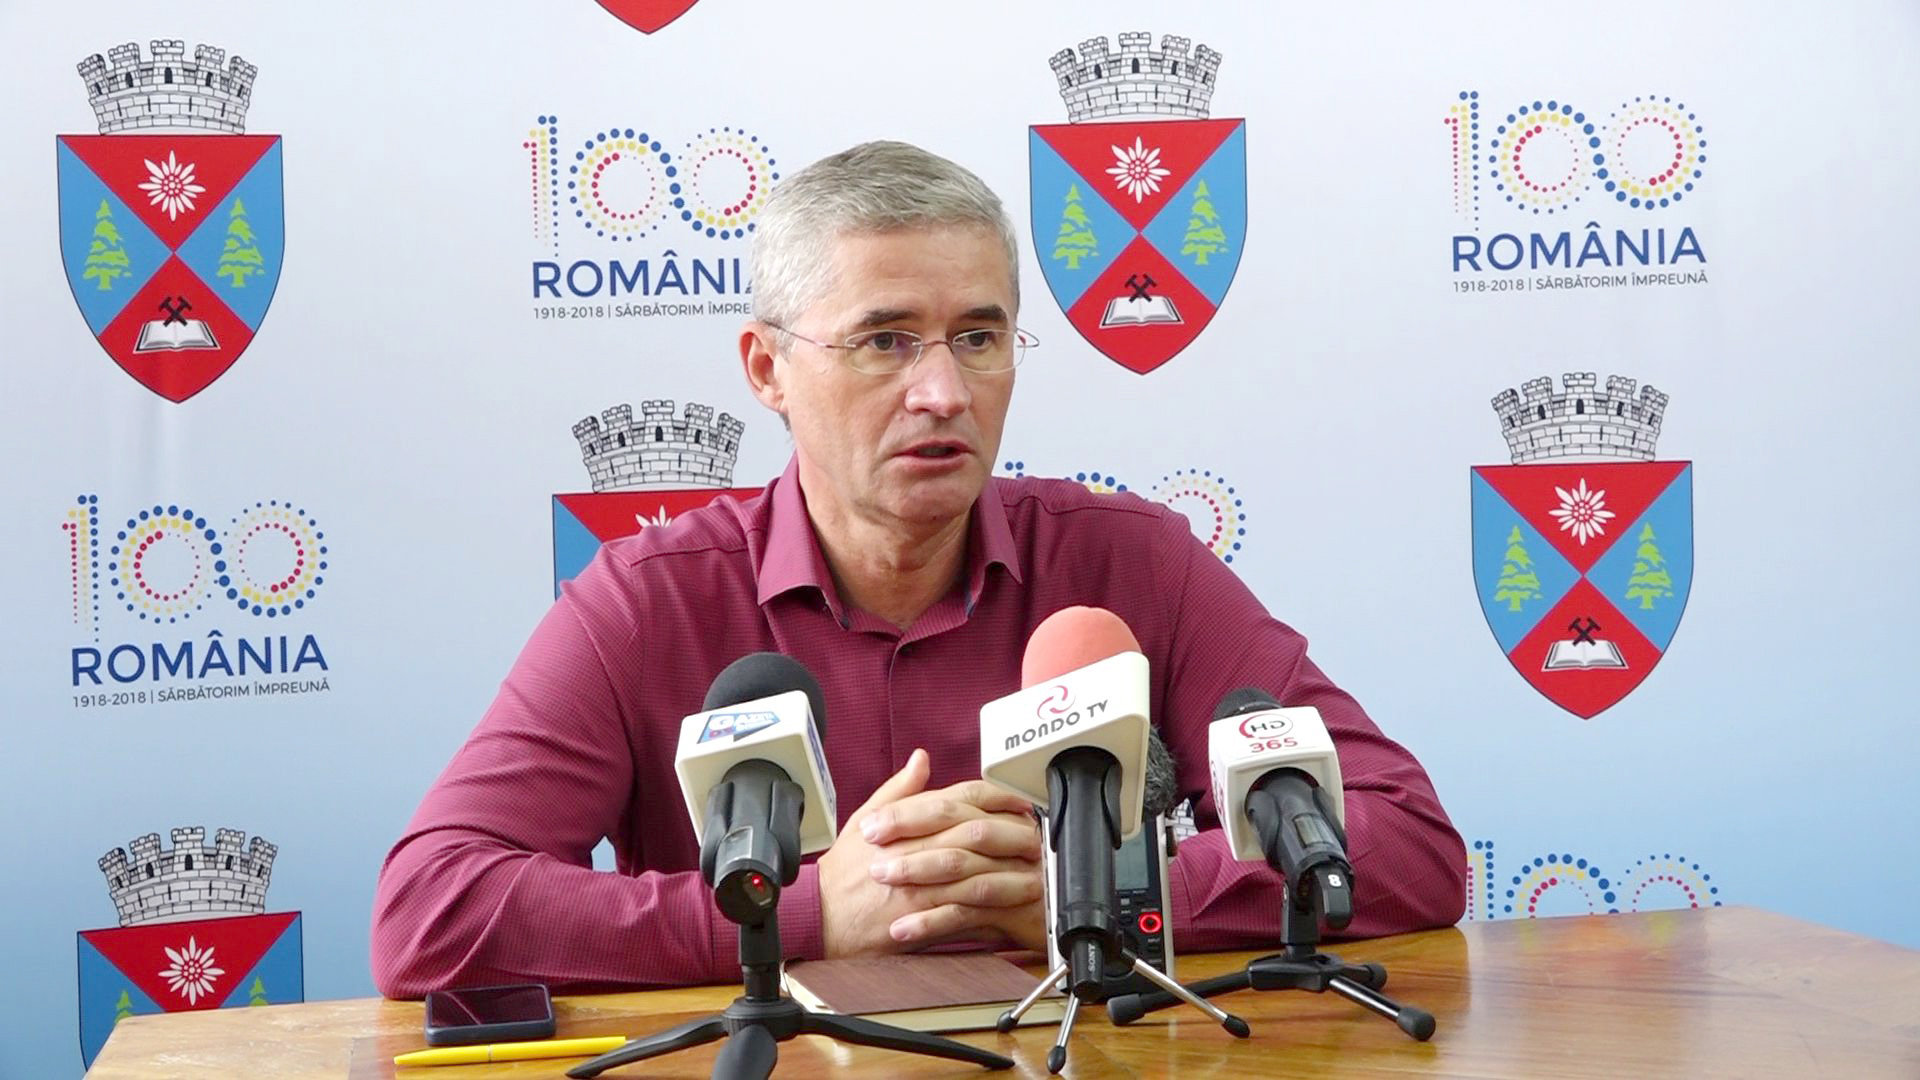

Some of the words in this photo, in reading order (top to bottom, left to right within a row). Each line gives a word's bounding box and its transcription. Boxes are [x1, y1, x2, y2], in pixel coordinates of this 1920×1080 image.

[1443, 90, 1707, 232] 100
[1452, 220, 1707, 273] ROMÂNIA
[532, 248, 752, 299] ROMÂNI
[1453, 279, 1525, 293] 1918-2018
[1535, 273, 1627, 291] SĂRBĂTORIM
[1631, 269, 1709, 287] ÎMPREUNĂ
[533, 306, 605, 320] 1918-2018
[615, 301, 704, 318] SĂRBĂTORIM
[708, 300, 751, 315] ÎMPRE
[61, 494, 329, 642] 100
[71, 629, 329, 687] ROMÂNIA
[72, 692, 147, 708] 1918-2018
[157, 685, 250, 703] SĂRBĂTORIM
[253, 677, 331, 697] ÎMPREUNĂ
[1004, 711, 1081, 751] MONDO
[1086, 699, 1109, 718] TV
[1248, 736, 1299, 753] 365
[1250, 719, 1286, 733] HD
[1087, 943, 1097, 974] SONY
